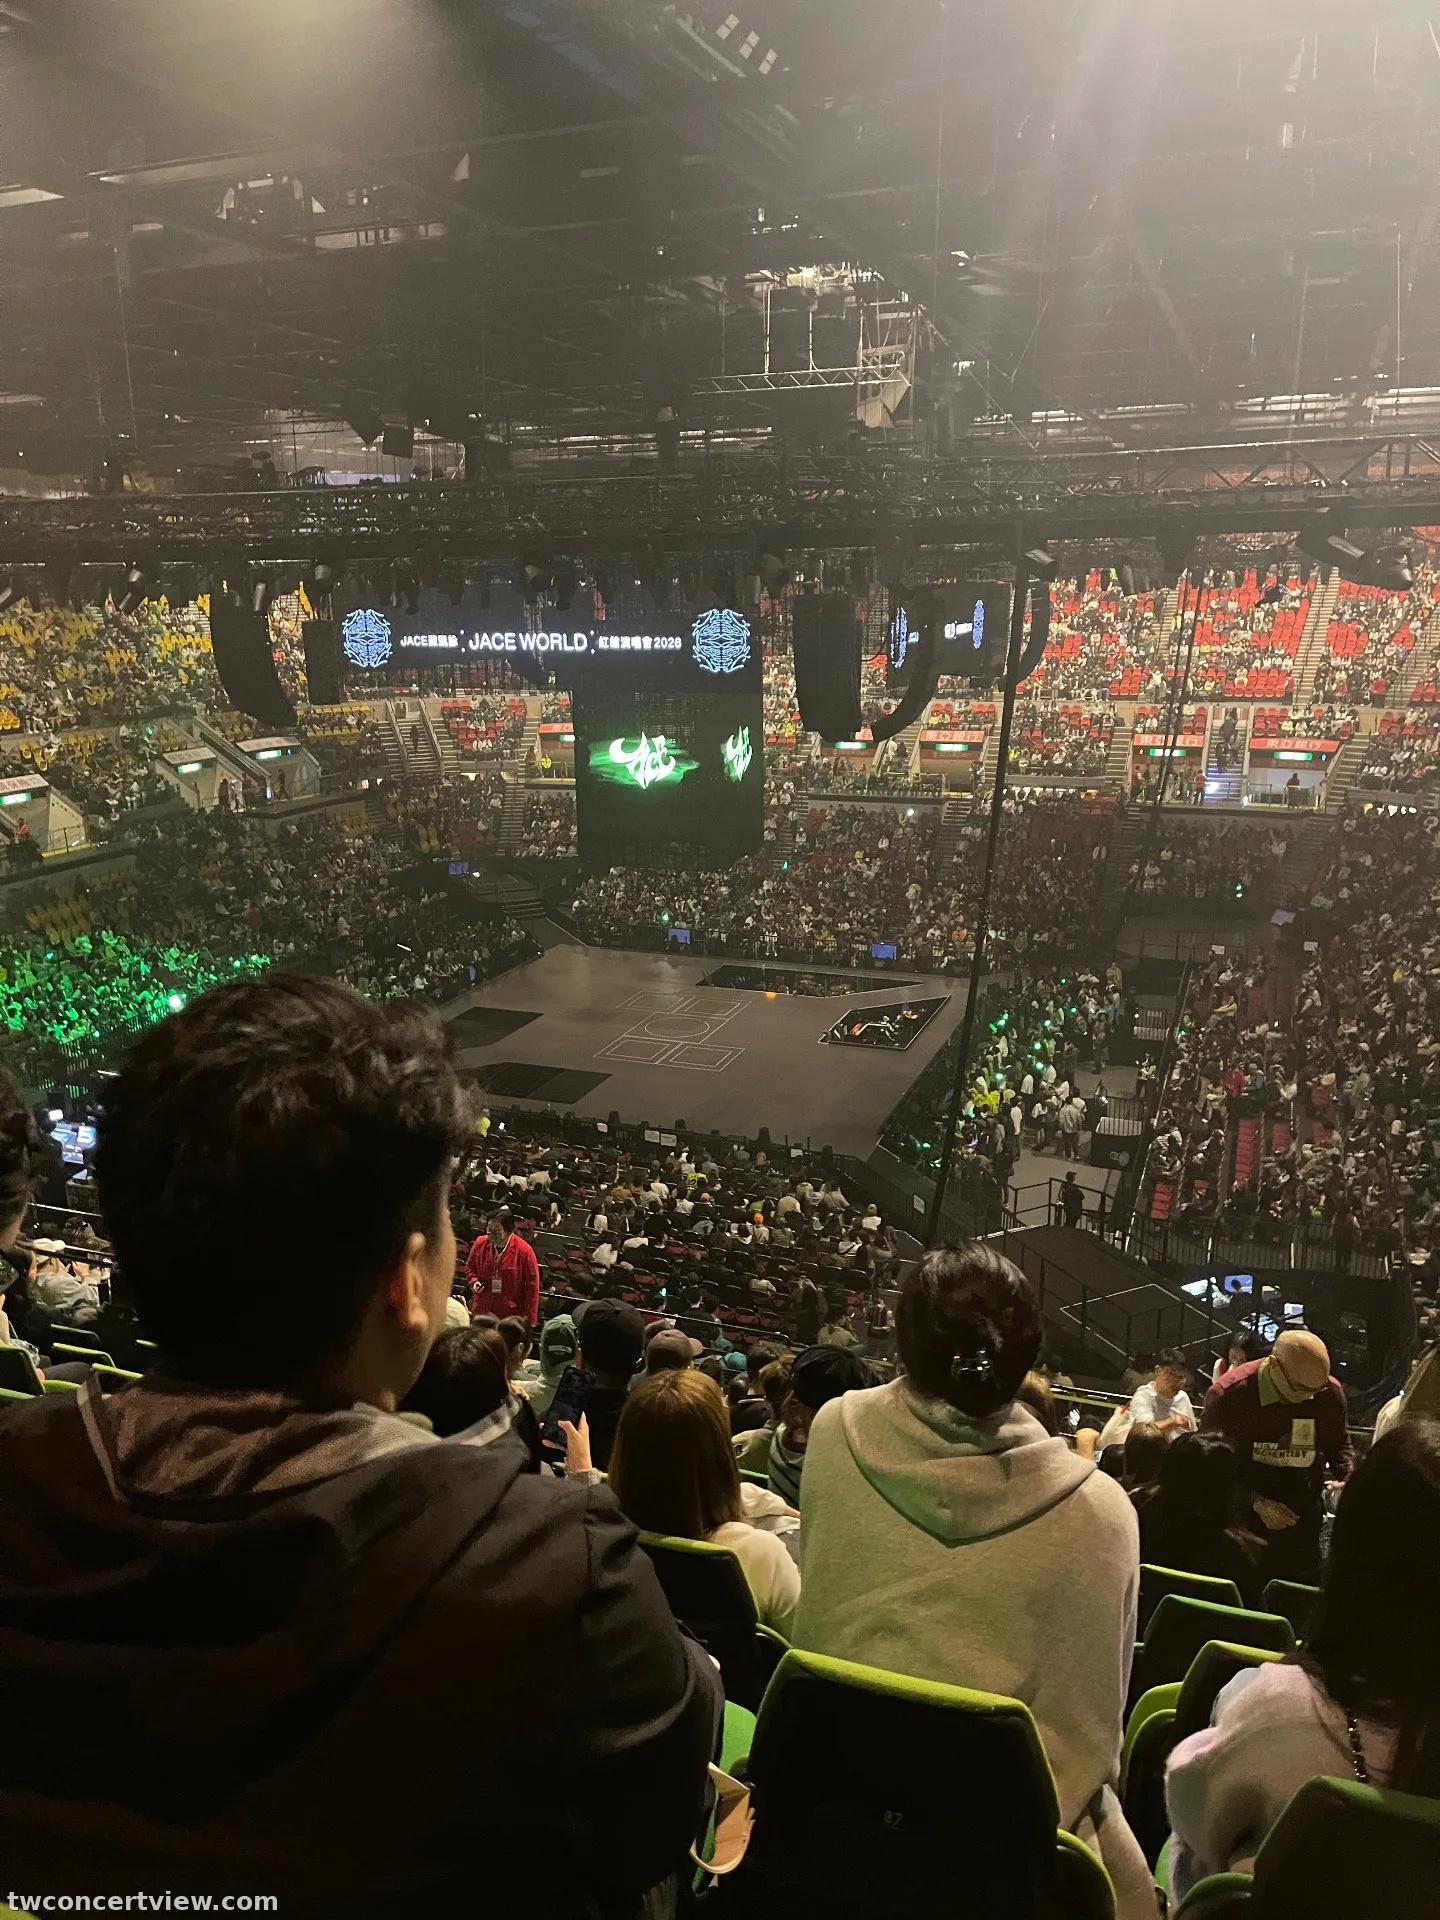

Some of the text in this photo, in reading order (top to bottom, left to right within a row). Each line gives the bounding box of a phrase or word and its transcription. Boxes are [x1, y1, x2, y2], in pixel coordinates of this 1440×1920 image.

[469, 633, 517, 651] JACE
[519, 633, 587, 651] WORLD
[1253, 1441, 1279, 1450] NEW
